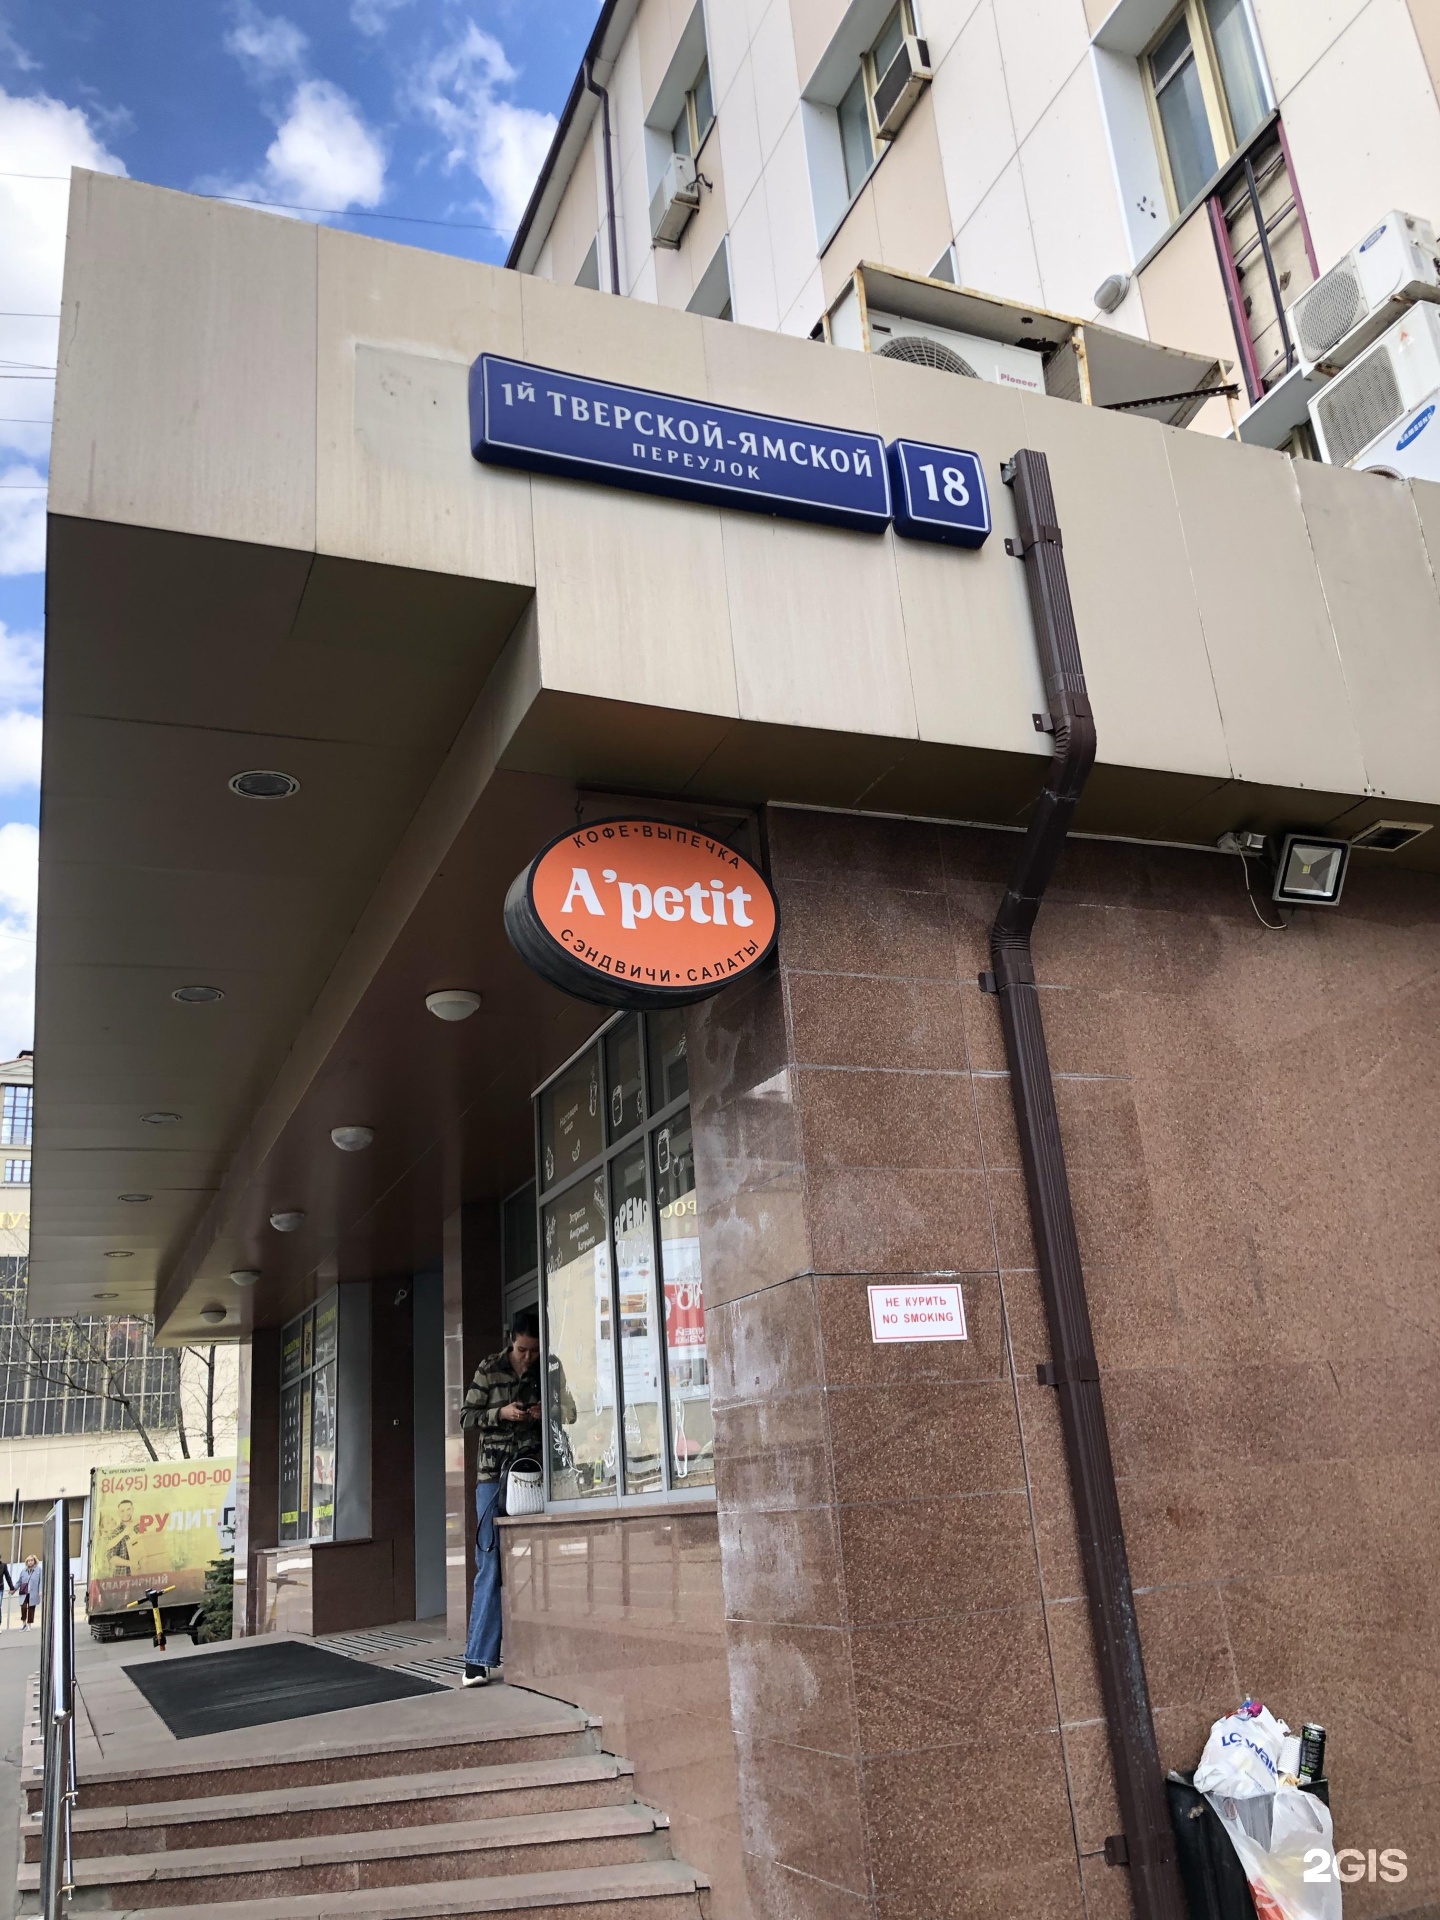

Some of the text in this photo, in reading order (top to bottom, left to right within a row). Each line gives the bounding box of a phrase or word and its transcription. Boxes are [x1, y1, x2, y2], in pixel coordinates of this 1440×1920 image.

[1000, 373, 1037, 388] Pioneer
[546, 390, 873, 478] ТВЕРСКОЙ-ЯМСКОЙ
[1400, 411, 1433, 444] SAMSUNG
[632, 442, 761, 481] ПЕРЕУЛОК
[919, 464, 970, 507] 18
[572, 825, 740, 869] КОФЕ ВЫПЕЧКА
[560, 929, 760, 983] СЭНДВИЧИ САЛАТЫ
[882, 1312, 954, 1324] NO SMOKING
[885, 1296, 947, 1307] НЕ КУРИТЬ
[101, 1468, 232, 1494] 8(495) 300-00-00
